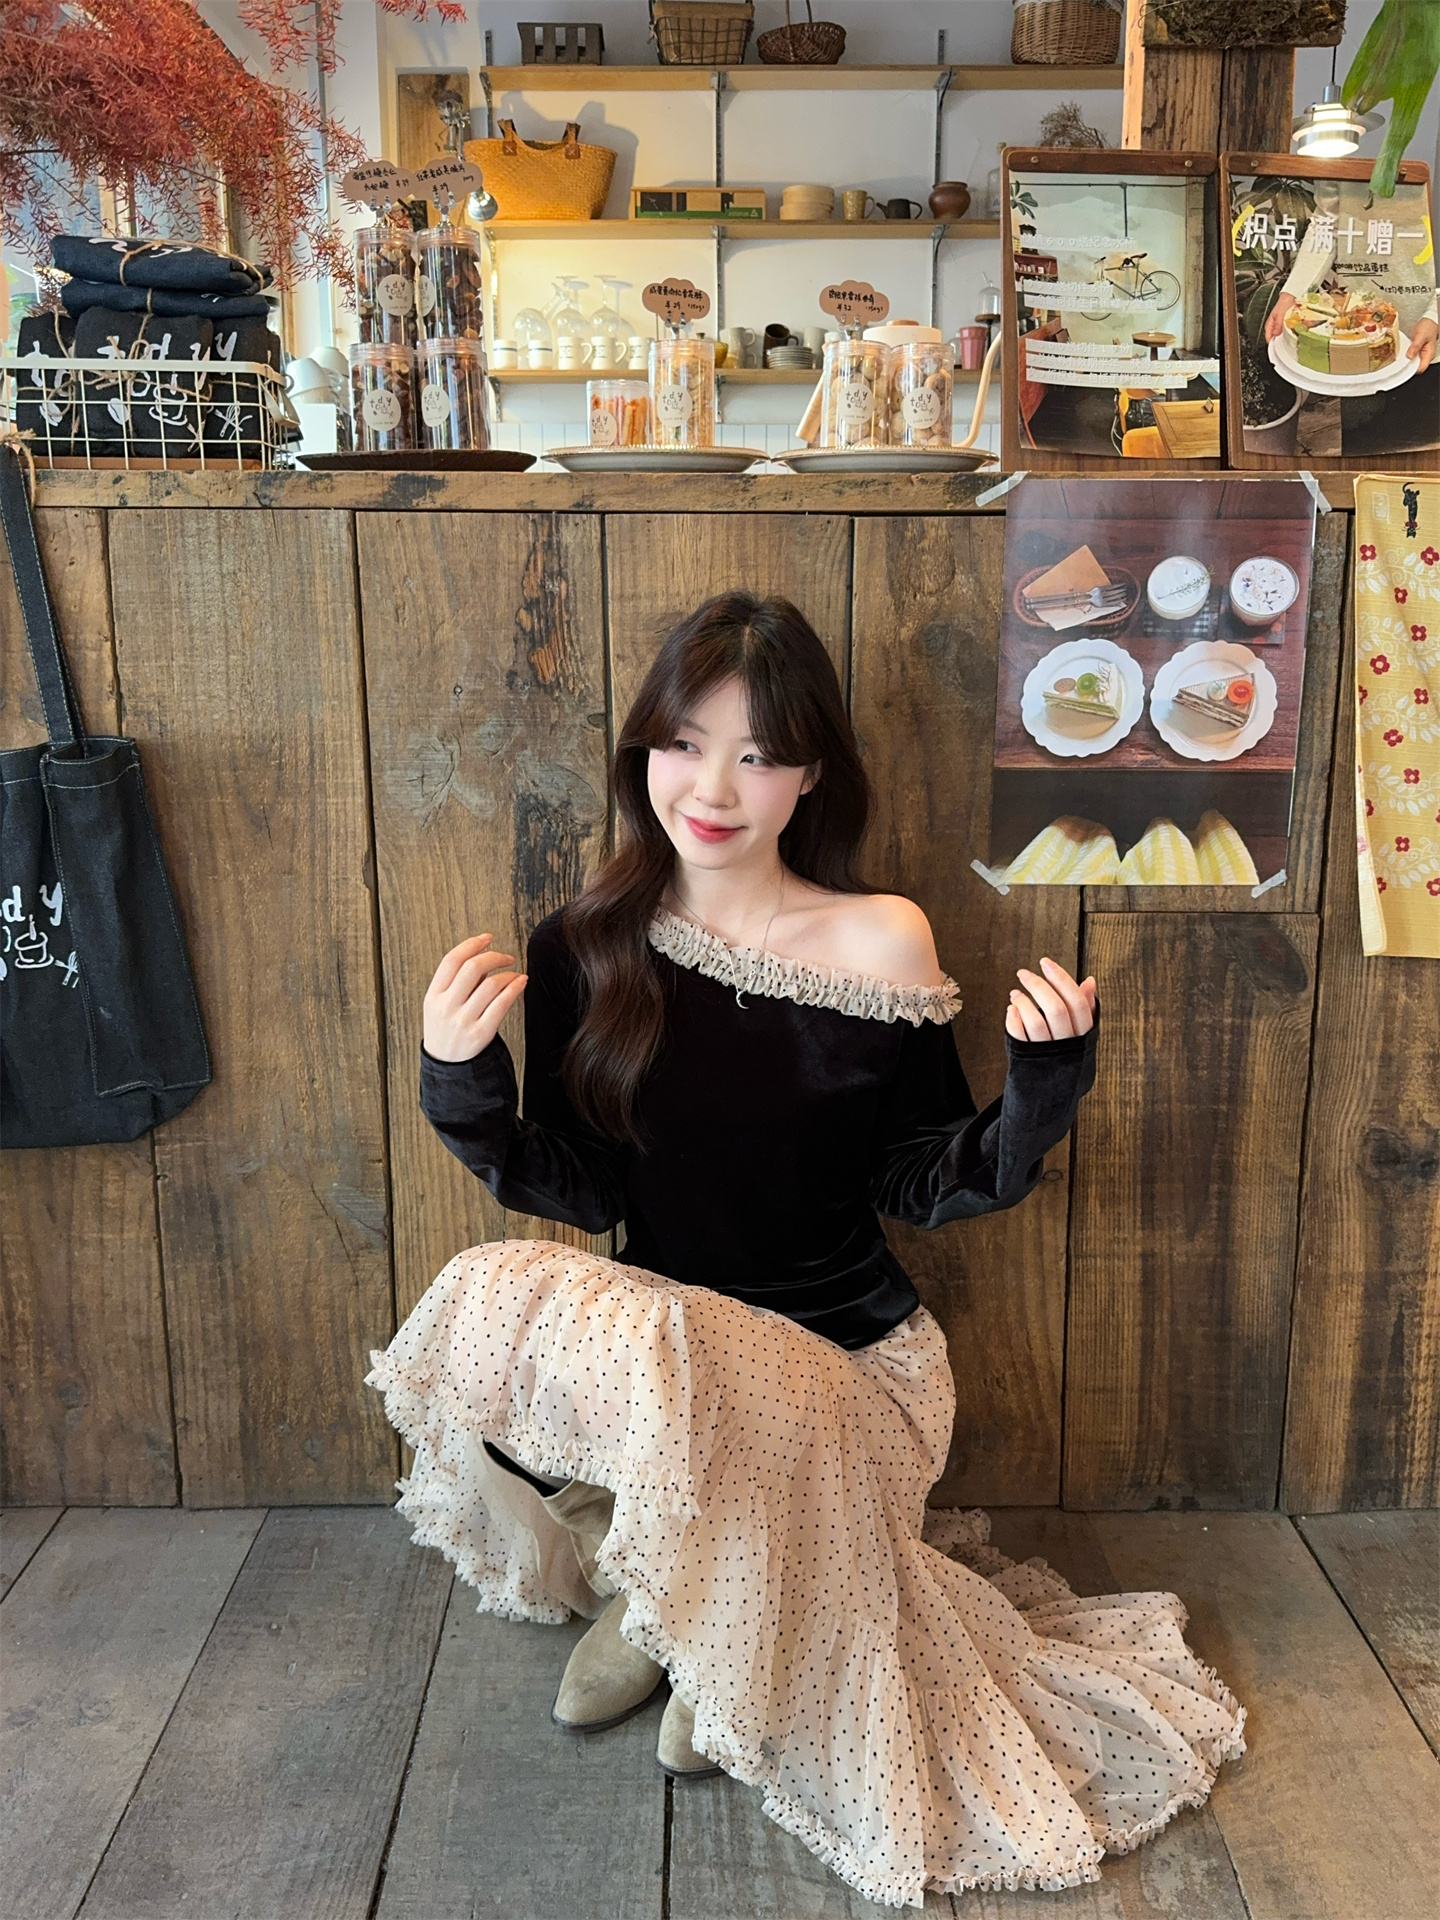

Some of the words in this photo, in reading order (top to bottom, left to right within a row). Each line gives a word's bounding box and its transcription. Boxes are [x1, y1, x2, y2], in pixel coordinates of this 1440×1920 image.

[1242, 213, 1298, 251] 积点
[1308, 215, 1424, 255] 满十赠一
